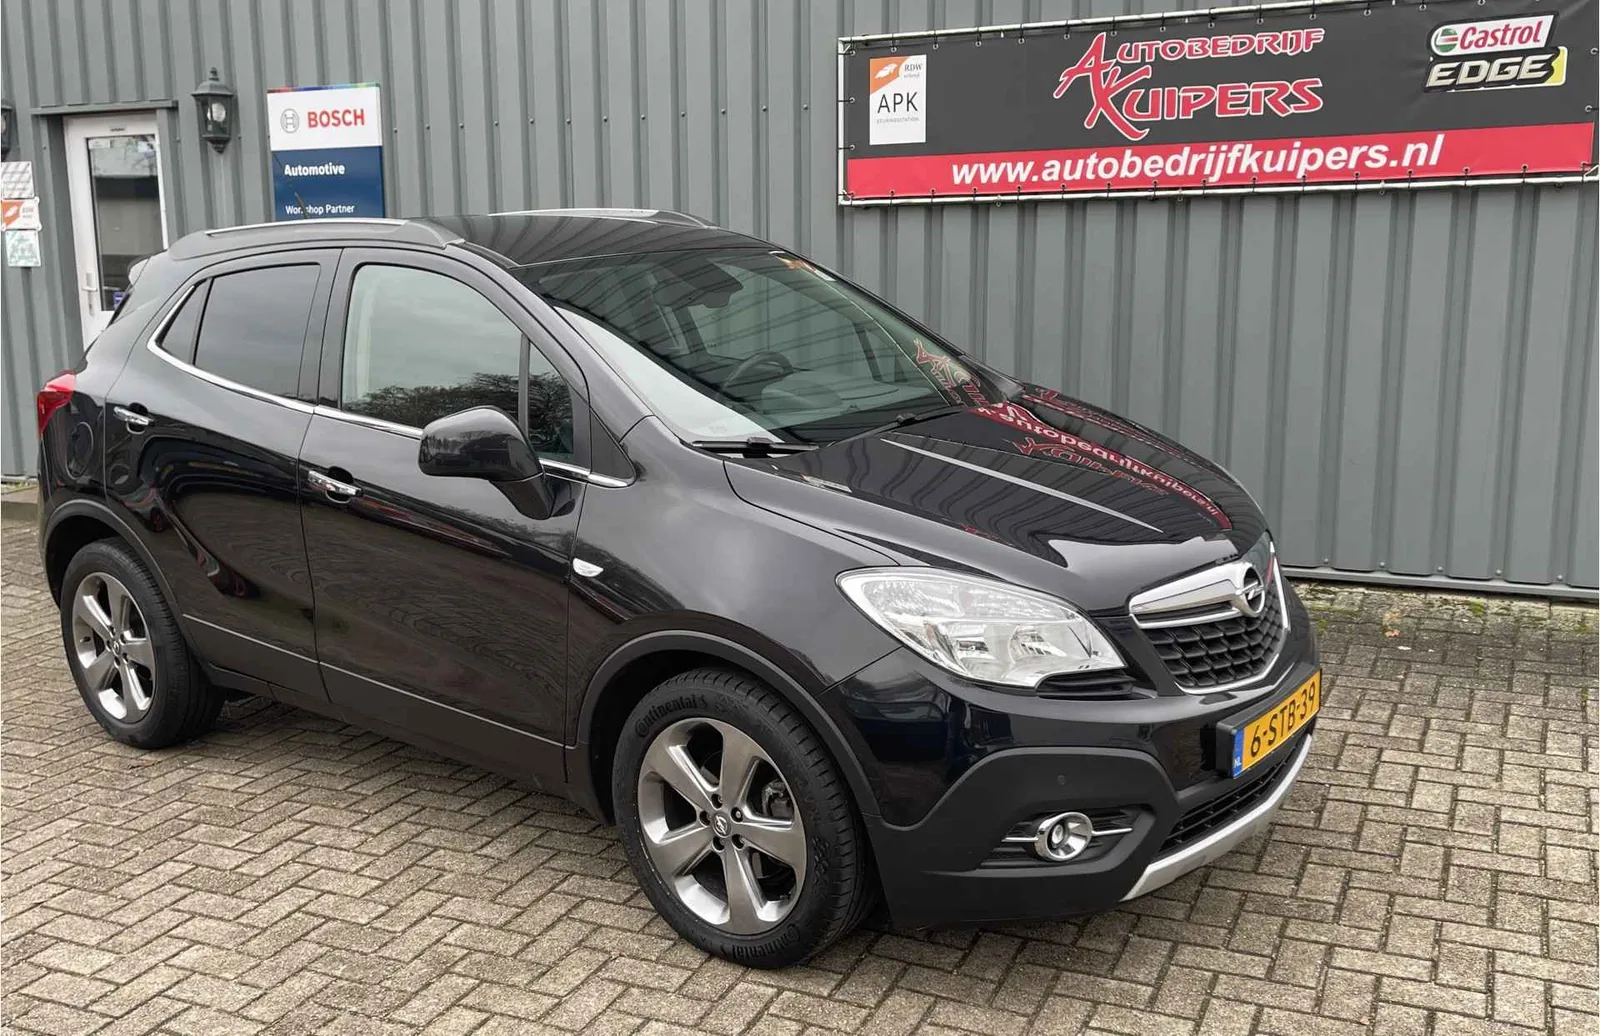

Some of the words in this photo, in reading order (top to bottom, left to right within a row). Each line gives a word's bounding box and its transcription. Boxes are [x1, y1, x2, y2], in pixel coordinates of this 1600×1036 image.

[1459, 20, 1543, 50] Castrol
[904, 63, 922, 72] RDW
[1053, 29, 1325, 98] AUTOBEDRIJF
[1425, 54, 1554, 88] EDGE
[877, 91, 918, 114] APK
[1084, 65, 1323, 141] KUIPERS
[307, 108, 365, 129] BOSCH
[284, 162, 346, 177] Automotive
[951, 133, 1445, 186] www.autobedrijfkuipers.nl
[285, 204, 324, 216] Worshop
[325, 203, 355, 214] Partner
[1250, 681, 1316, 758] 6-STB-39
